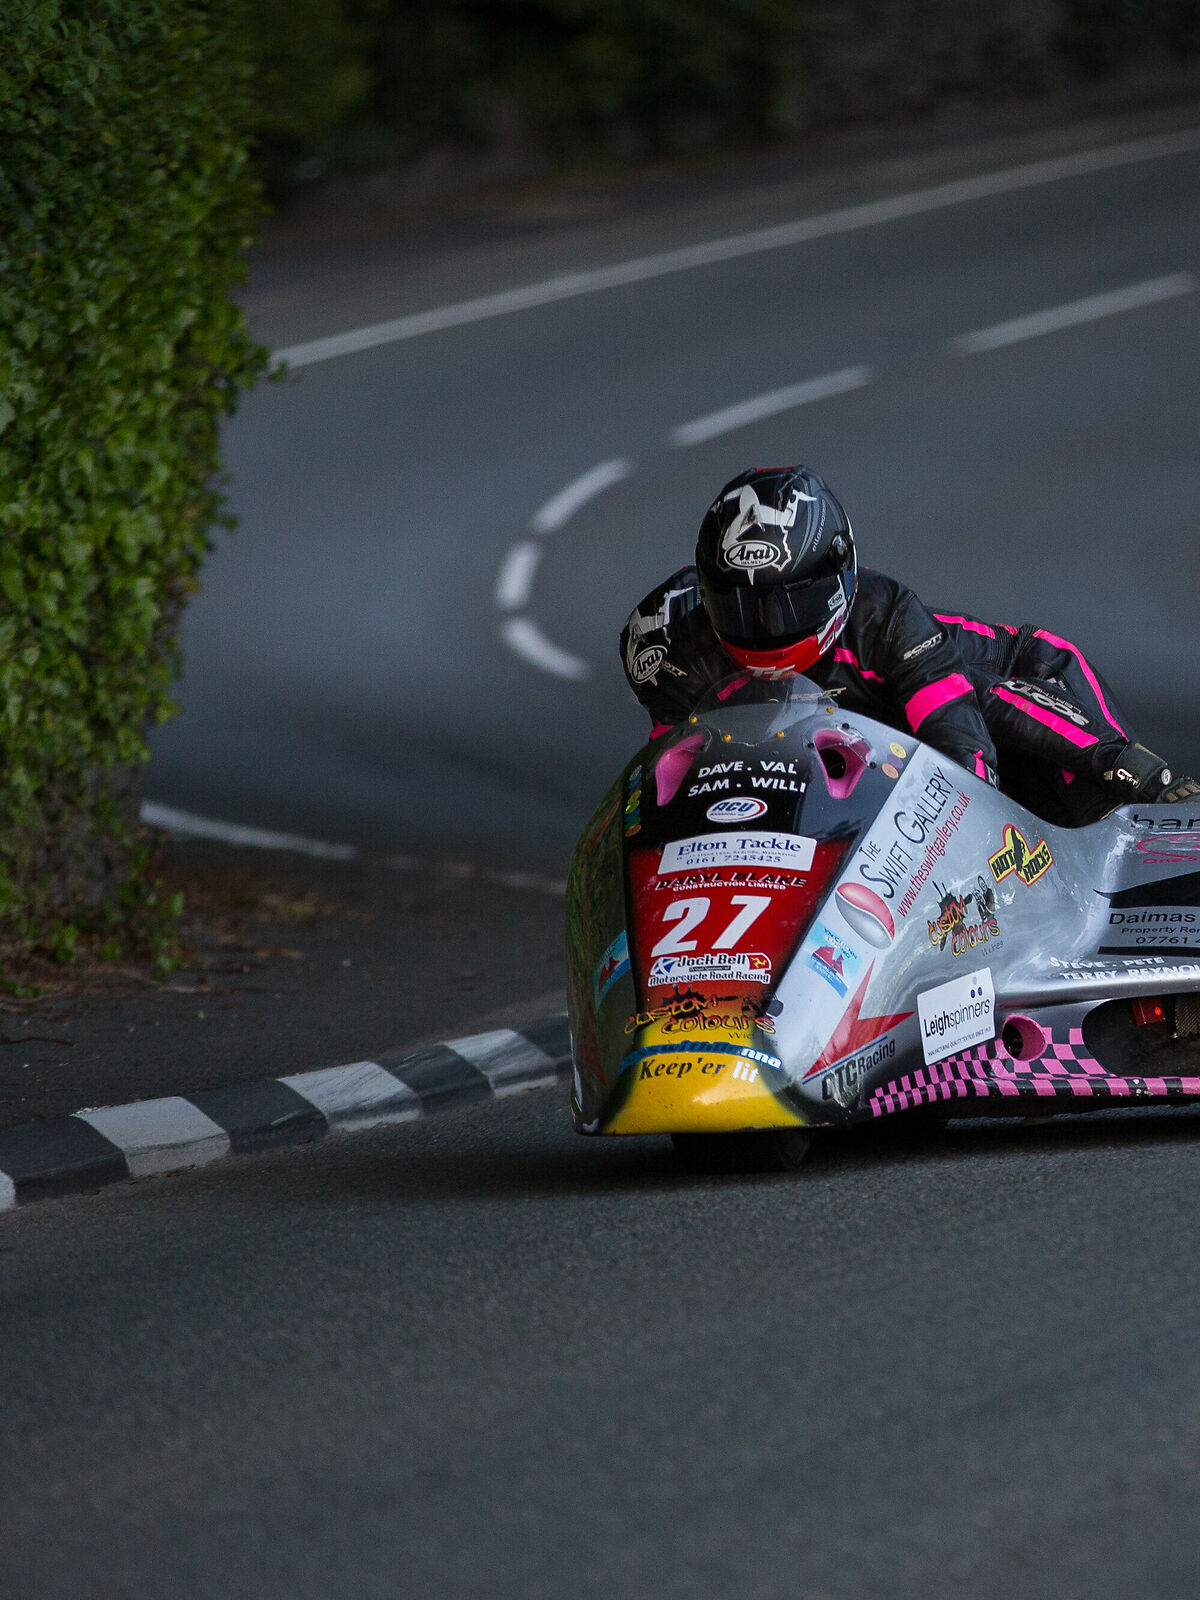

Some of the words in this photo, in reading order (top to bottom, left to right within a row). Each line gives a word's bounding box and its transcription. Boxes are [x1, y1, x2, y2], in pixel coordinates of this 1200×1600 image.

[730, 545, 772, 561] Arai
[903, 631, 942, 660] SCOTT
[636, 649, 660, 676] Arai
[698, 761, 744, 778] DAVE
[760, 761, 797, 775] VAL
[688, 779, 730, 797] SAM
[712, 802, 756, 812] ACU
[678, 840, 728, 856] Elton
[736, 838, 802, 852] Tackle
[897, 790, 972, 918] www.theswiftgallery.co.uk
[686, 856, 716, 865] 0161
[991, 848, 1016, 879] HOT
[1142, 857, 1182, 865] One
[673, 881, 746, 892] CONSTRUCTION
[748, 881, 787, 890] LIMITED
[650, 895, 772, 957] 27
[1108, 911, 1196, 925] Daimas
[1121, 926, 1177, 935] Property
[1135, 936, 1188, 945] 07761
[717, 954, 746, 966] Bell
[1123, 956, 1165, 967] PETE
[649, 971, 708, 986] Motorcycle
[709, 970, 734, 980] Road
[735, 971, 770, 983] Racing
[1060, 970, 1117, 980] TERRY
[923, 998, 991, 1038] Leighspinners
[639, 1057, 726, 1080] Keep'er
[732, 1061, 760, 1083] lit
